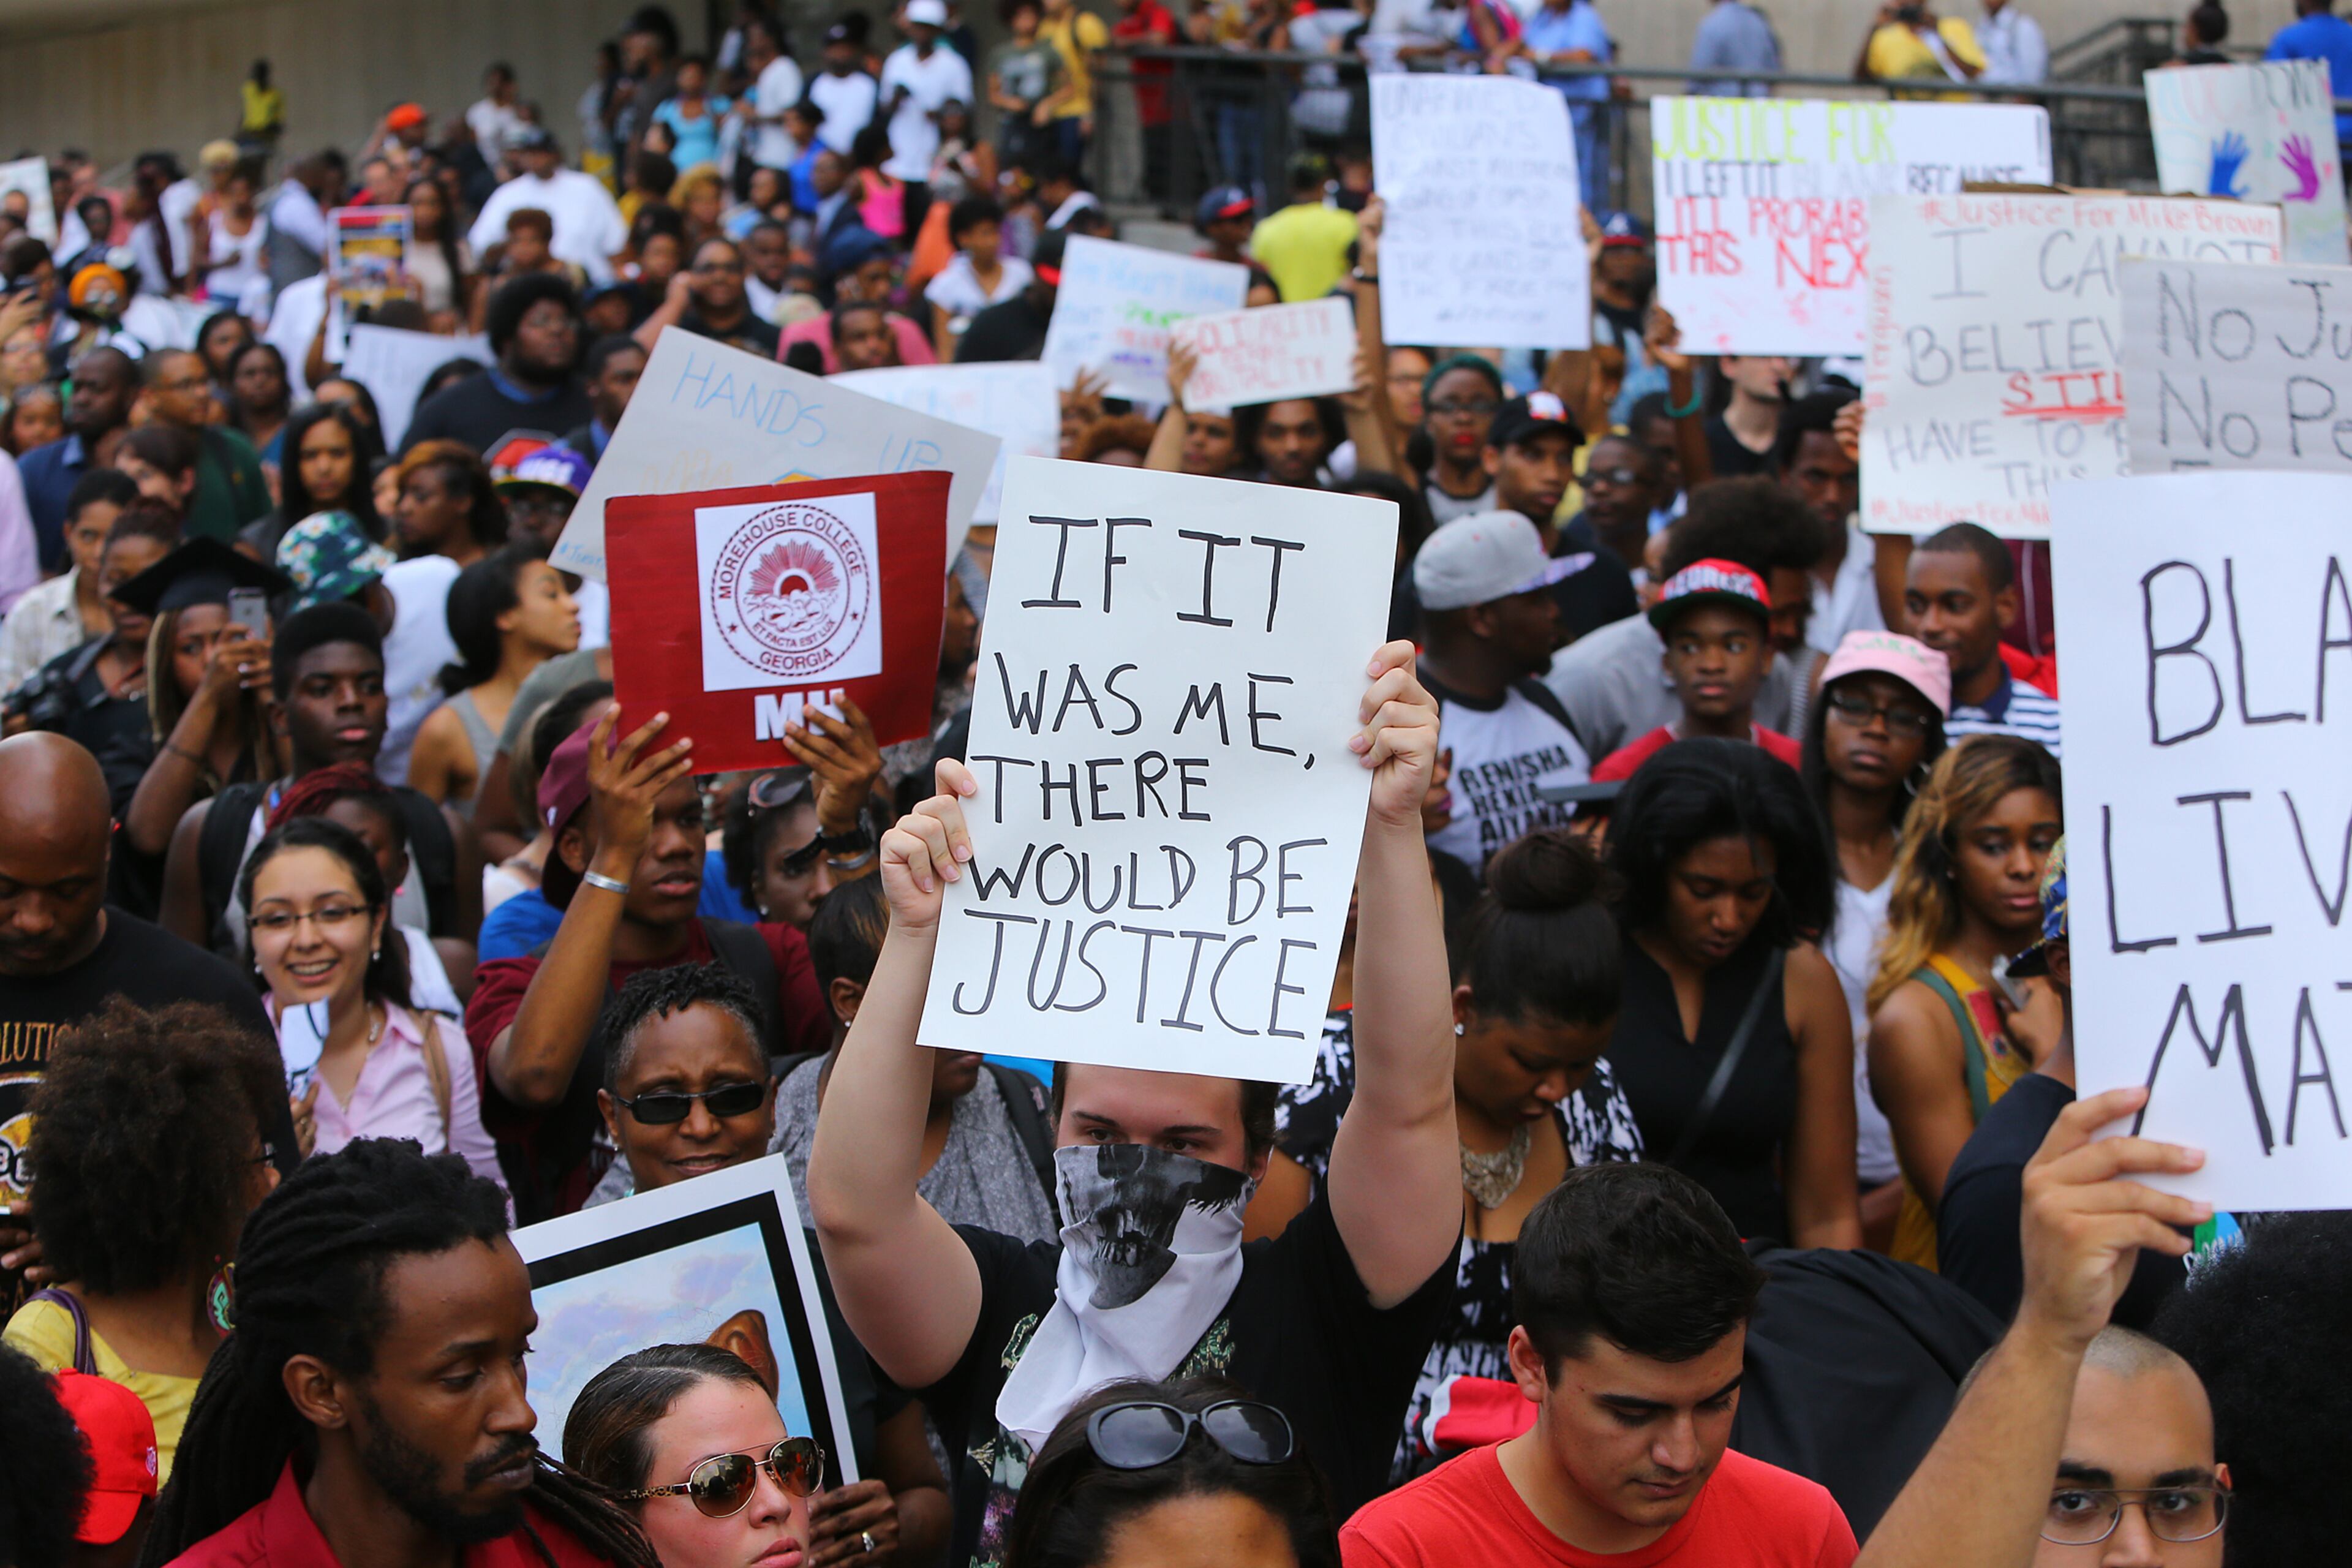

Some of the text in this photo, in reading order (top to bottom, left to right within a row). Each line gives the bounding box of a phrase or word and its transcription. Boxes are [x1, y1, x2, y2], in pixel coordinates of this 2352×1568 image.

[1654, 98, 1896, 164] JUSTICE FOR
[1656, 235, 1869, 289] THIS NEX
[1747, 197, 1869, 239] PROBAB
[1931, 227, 1988, 300] I
[2157, 268, 2257, 363] No
[670, 351, 827, 448] HANDS
[878, 432, 942, 474] UP
[1883, 417, 1997, 470] HAVE
[2022, 418, 2085, 458] TO
[2157, 368, 2261, 461] No
[718, 511, 863, 600] MOREHOUSE COLLEGE
[1021, 514, 1305, 633] IF IT
[752, 617, 836, 648] ET FACTA EST LUX
[759, 647, 834, 671] GEORGIA
[2139, 556, 2352, 747] BLA
[993, 651, 1315, 771] WAS ME,
[970, 749, 1212, 827] THERE
[968, 835, 1328, 925] WOULD BE
[2101, 789, 2352, 954] LIV
[951, 907, 1318, 1040] JUSTICE
[2130, 982, 2352, 1156] MA
